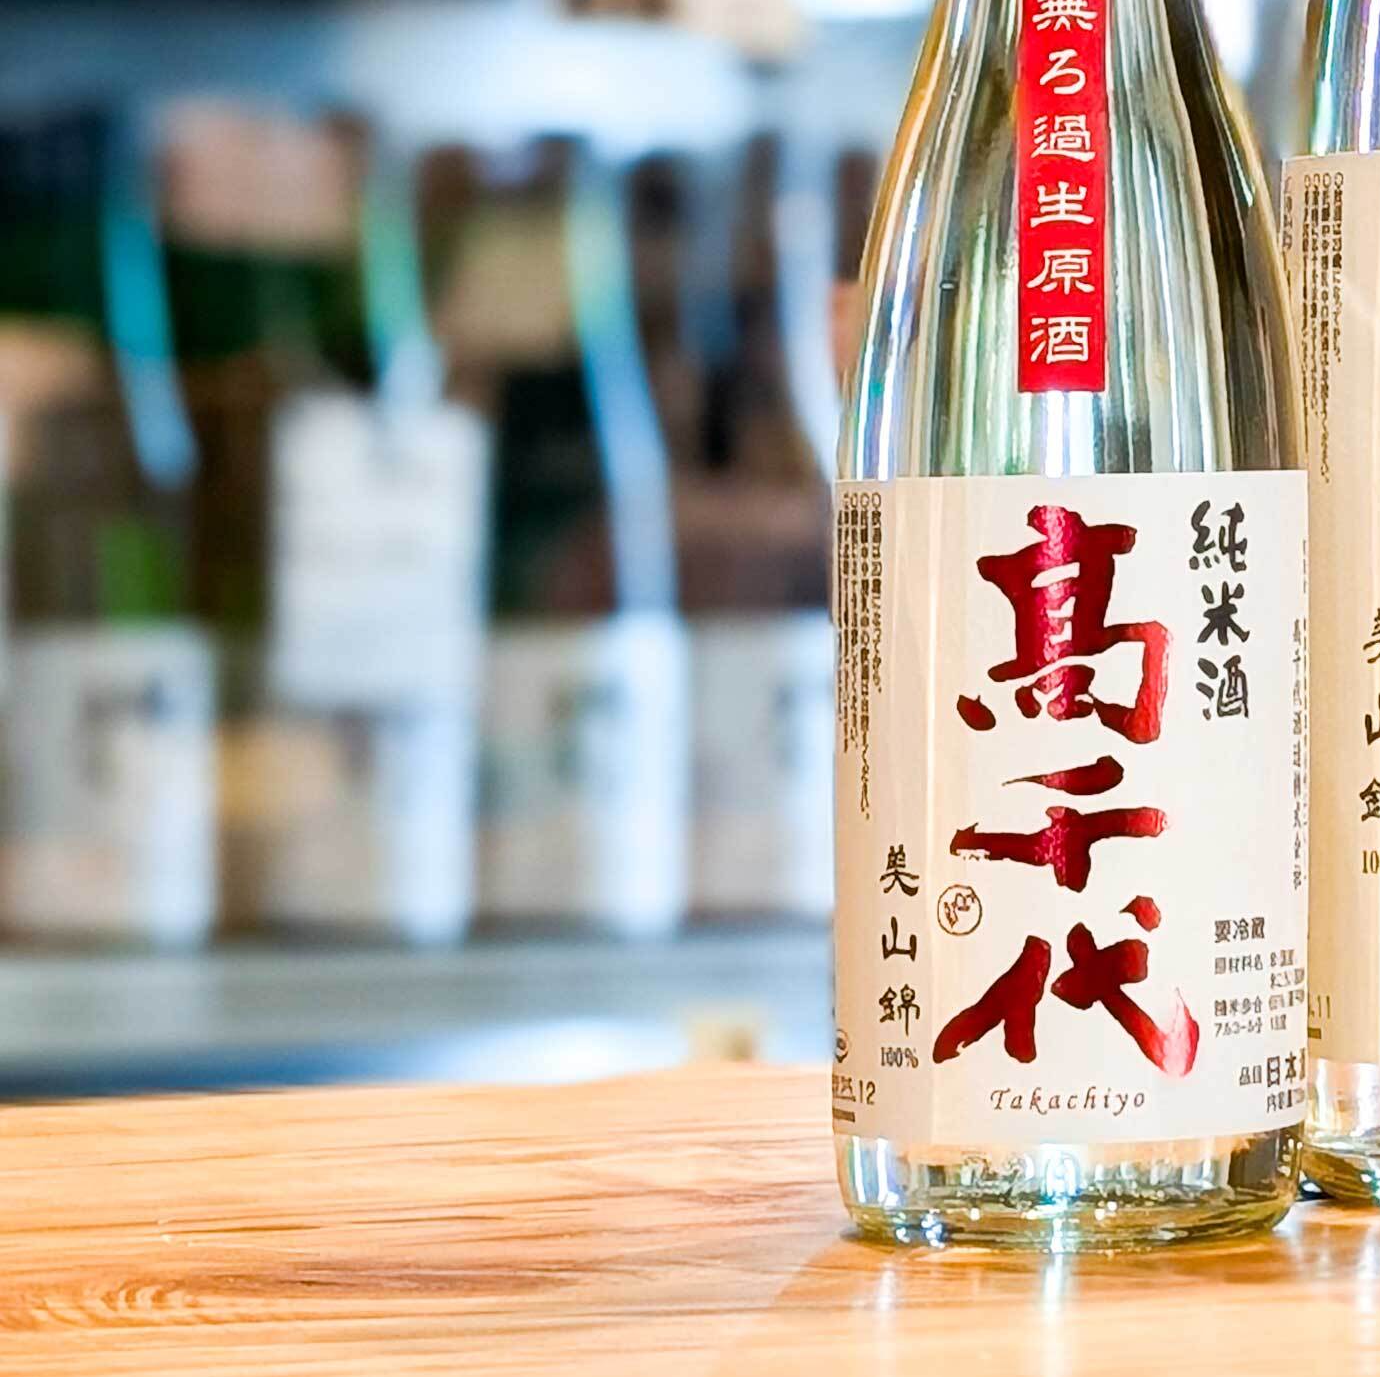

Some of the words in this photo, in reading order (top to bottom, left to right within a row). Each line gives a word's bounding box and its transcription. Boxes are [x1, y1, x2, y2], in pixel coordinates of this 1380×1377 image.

[1189, 500, 1251, 721] 純米酒
[878, 843, 921, 1036] 美山錦
[880, 1046, 919, 1069] 100%
[990, 1086, 1145, 1116] Takachiyo
